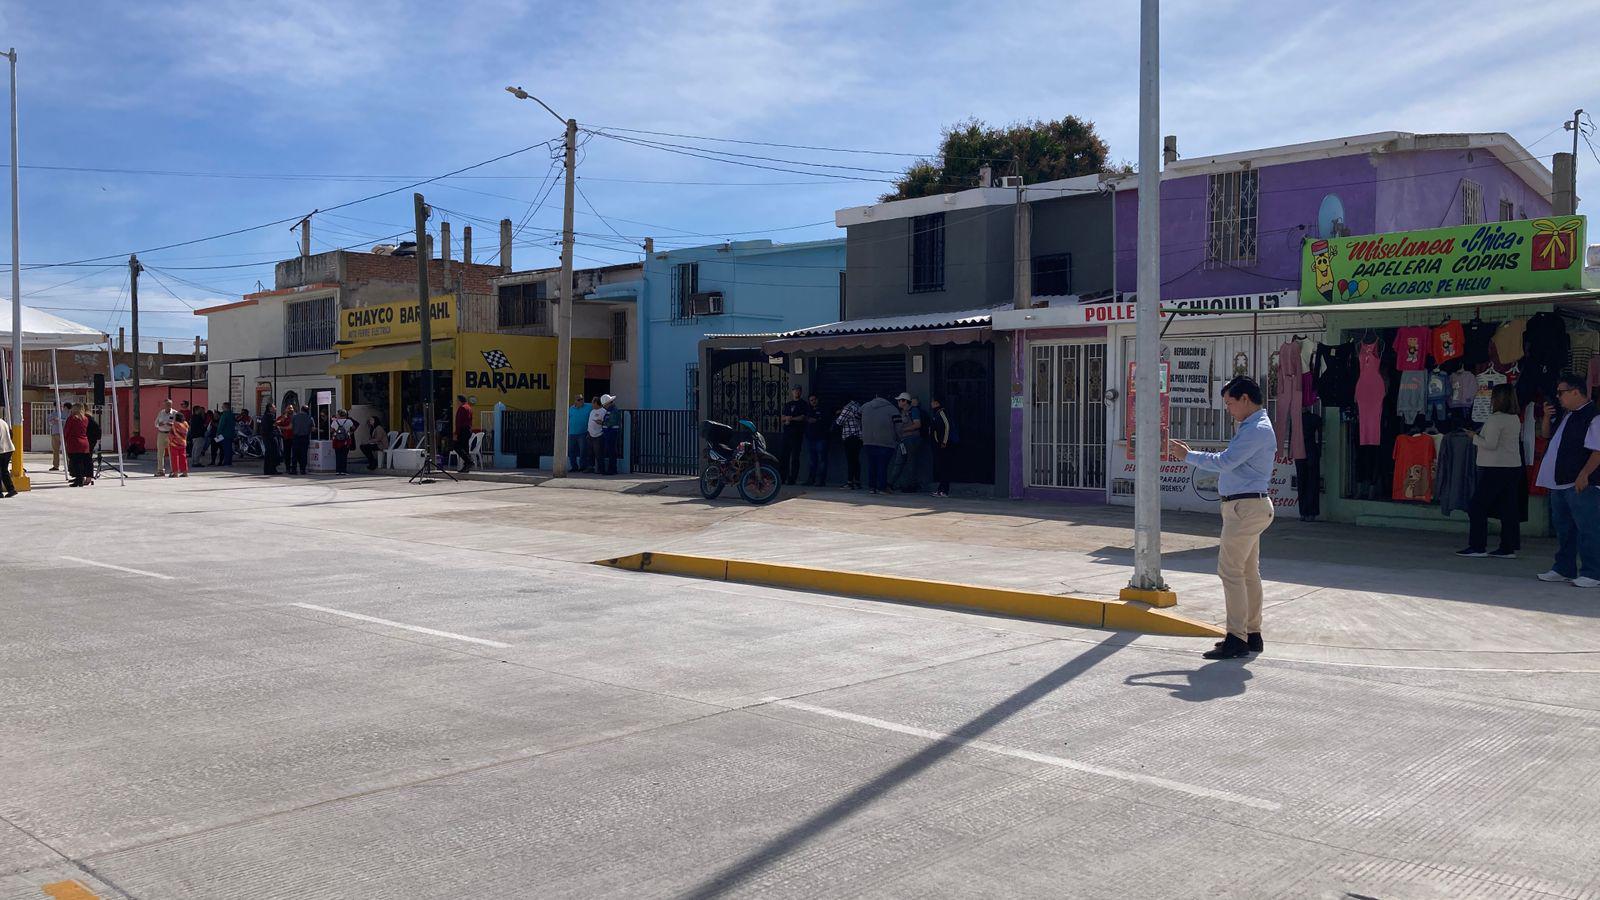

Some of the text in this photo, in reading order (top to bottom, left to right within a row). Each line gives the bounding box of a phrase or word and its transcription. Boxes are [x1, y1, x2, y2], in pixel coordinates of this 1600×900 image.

[1348, 237, 1455, 262] Miselanea
[1352, 252, 1521, 278] PAPELERIA COPIAS
[1380, 281, 1433, 296] GLOBOS
[1455, 276, 1492, 292] HELIO
[347, 301, 450, 328] CHAYCO BARAHL
[465, 370, 550, 393] BARDAHL
[1159, 465, 1188, 473] UGGETS
